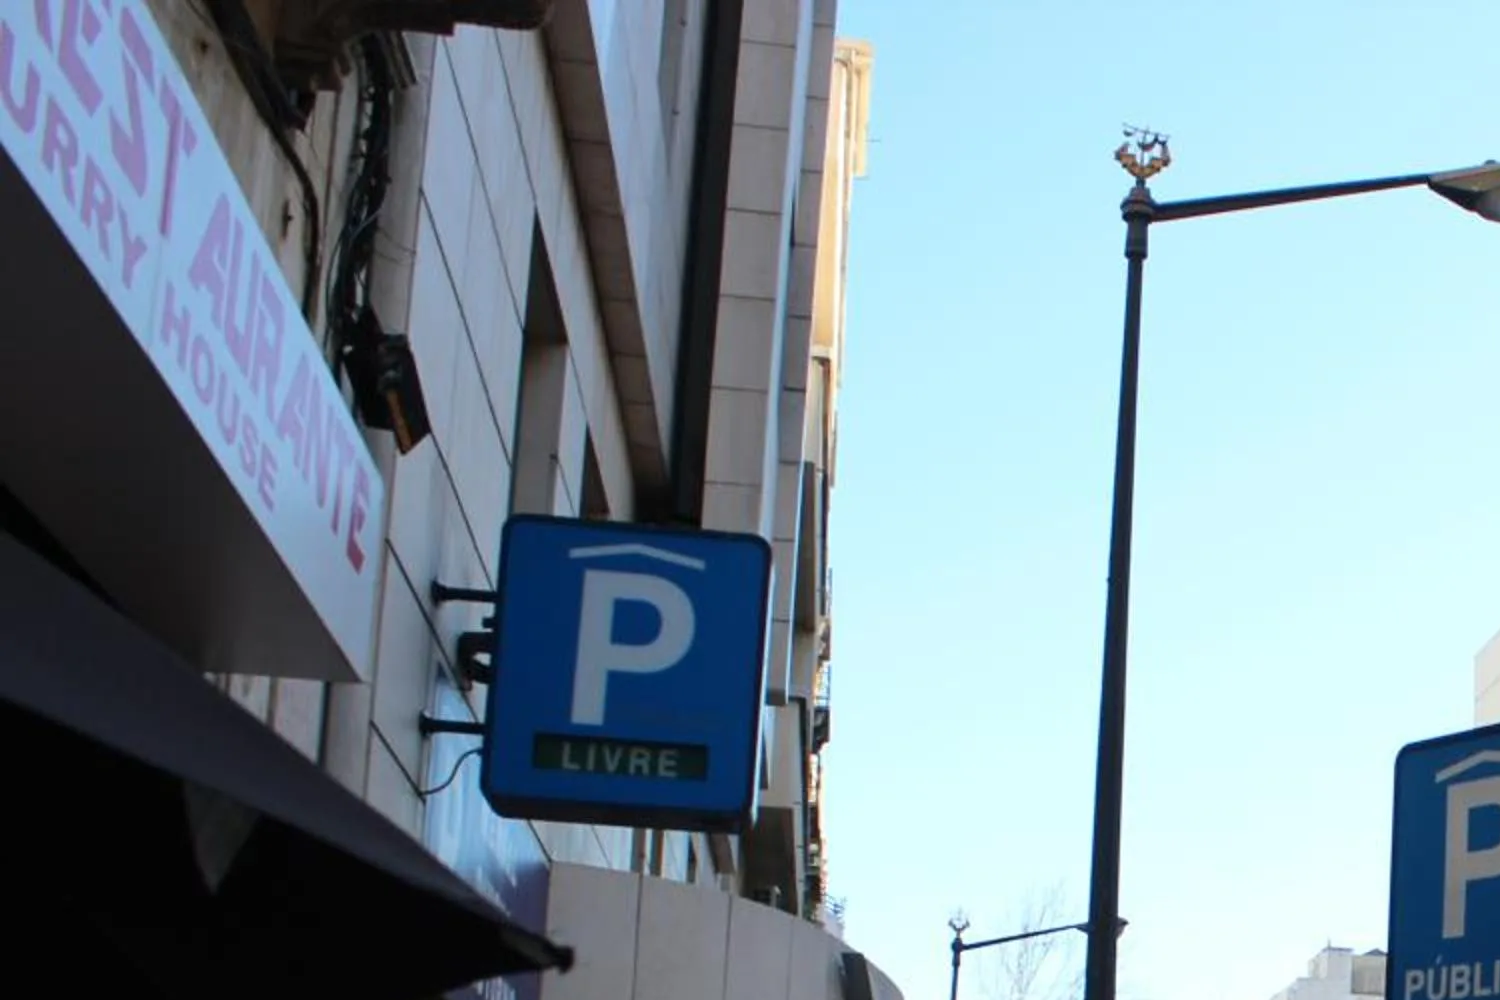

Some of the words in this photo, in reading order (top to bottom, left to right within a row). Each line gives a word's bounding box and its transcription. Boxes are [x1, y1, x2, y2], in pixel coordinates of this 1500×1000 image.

[160, 281, 279, 513] HOUSE
[570, 569, 696, 726] P
[560, 741, 681, 778] LIVRE
